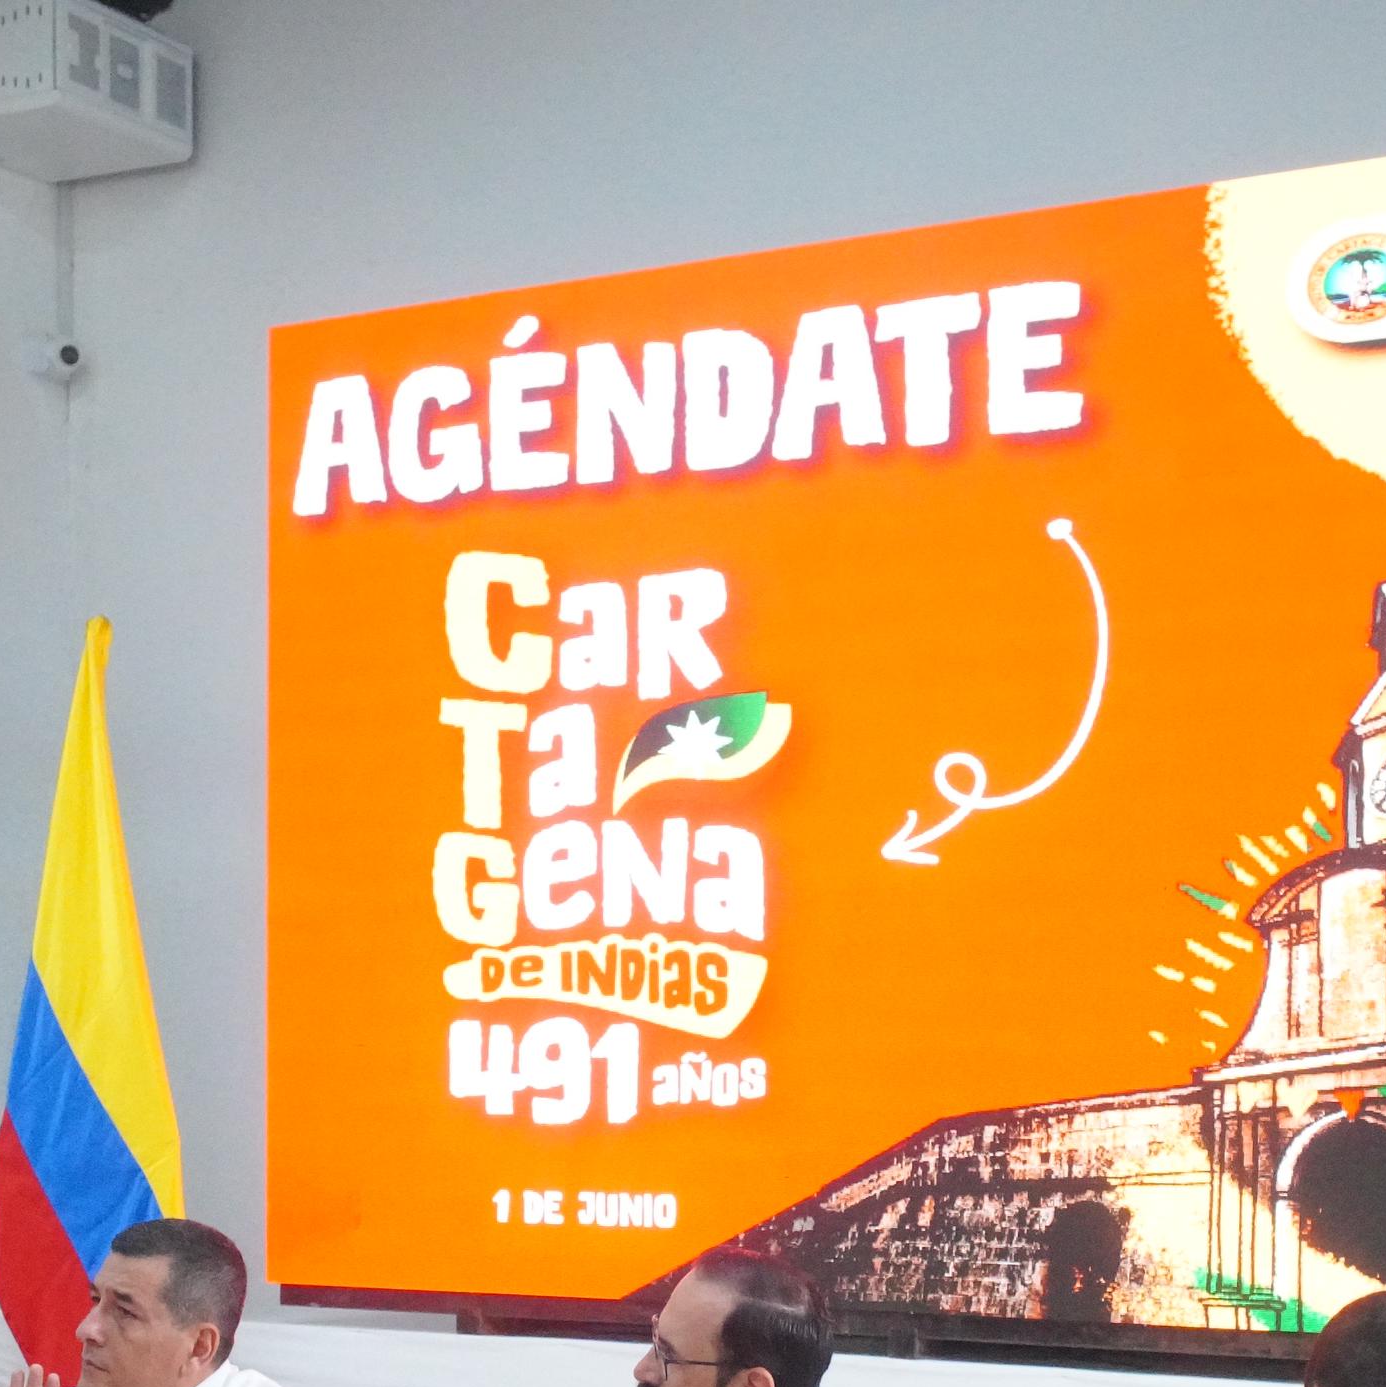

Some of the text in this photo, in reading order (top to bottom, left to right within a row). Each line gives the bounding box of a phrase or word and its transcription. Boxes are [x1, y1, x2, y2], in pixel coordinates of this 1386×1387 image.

[293, 281, 1084, 517] AGÉNDATE
[449, 1017, 639, 1125] 491
[492, 1189, 677, 1229] 1 DE JUNIO
